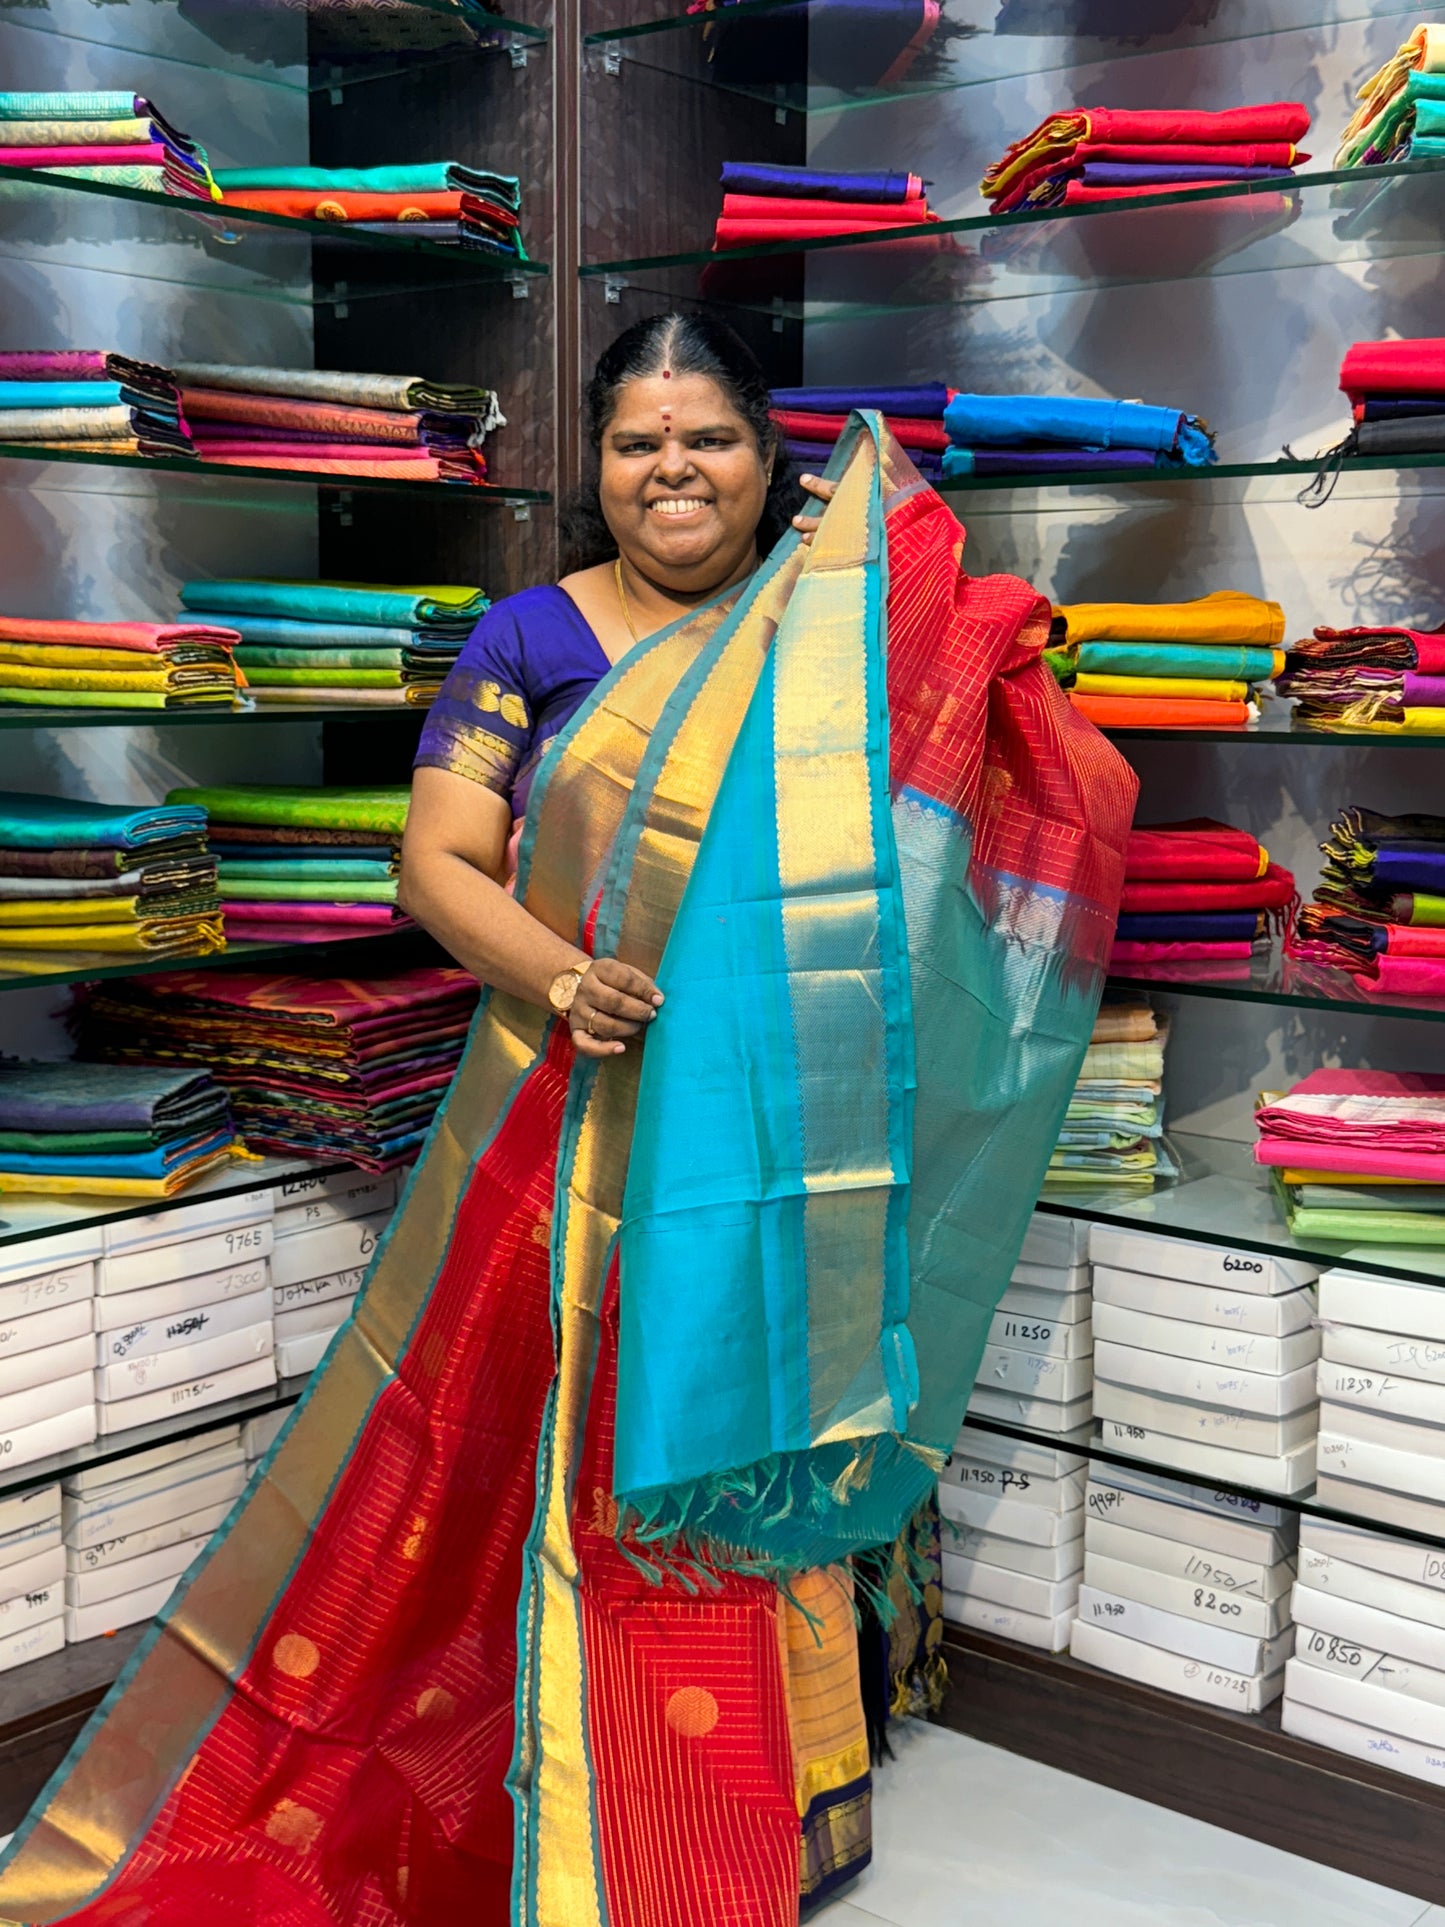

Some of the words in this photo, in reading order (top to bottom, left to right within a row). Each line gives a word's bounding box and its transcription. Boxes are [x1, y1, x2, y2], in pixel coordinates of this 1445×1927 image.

[225, 1230, 263, 1254] 9765
[1223, 1255, 1263, 1274] 6200
[1005, 1321, 1051, 1340] 11250
[1193, 1588, 1242, 1616] 8200
[1307, 1631, 1395, 1682] 10850/-
[1206, 1670, 1250, 1694] 10725
